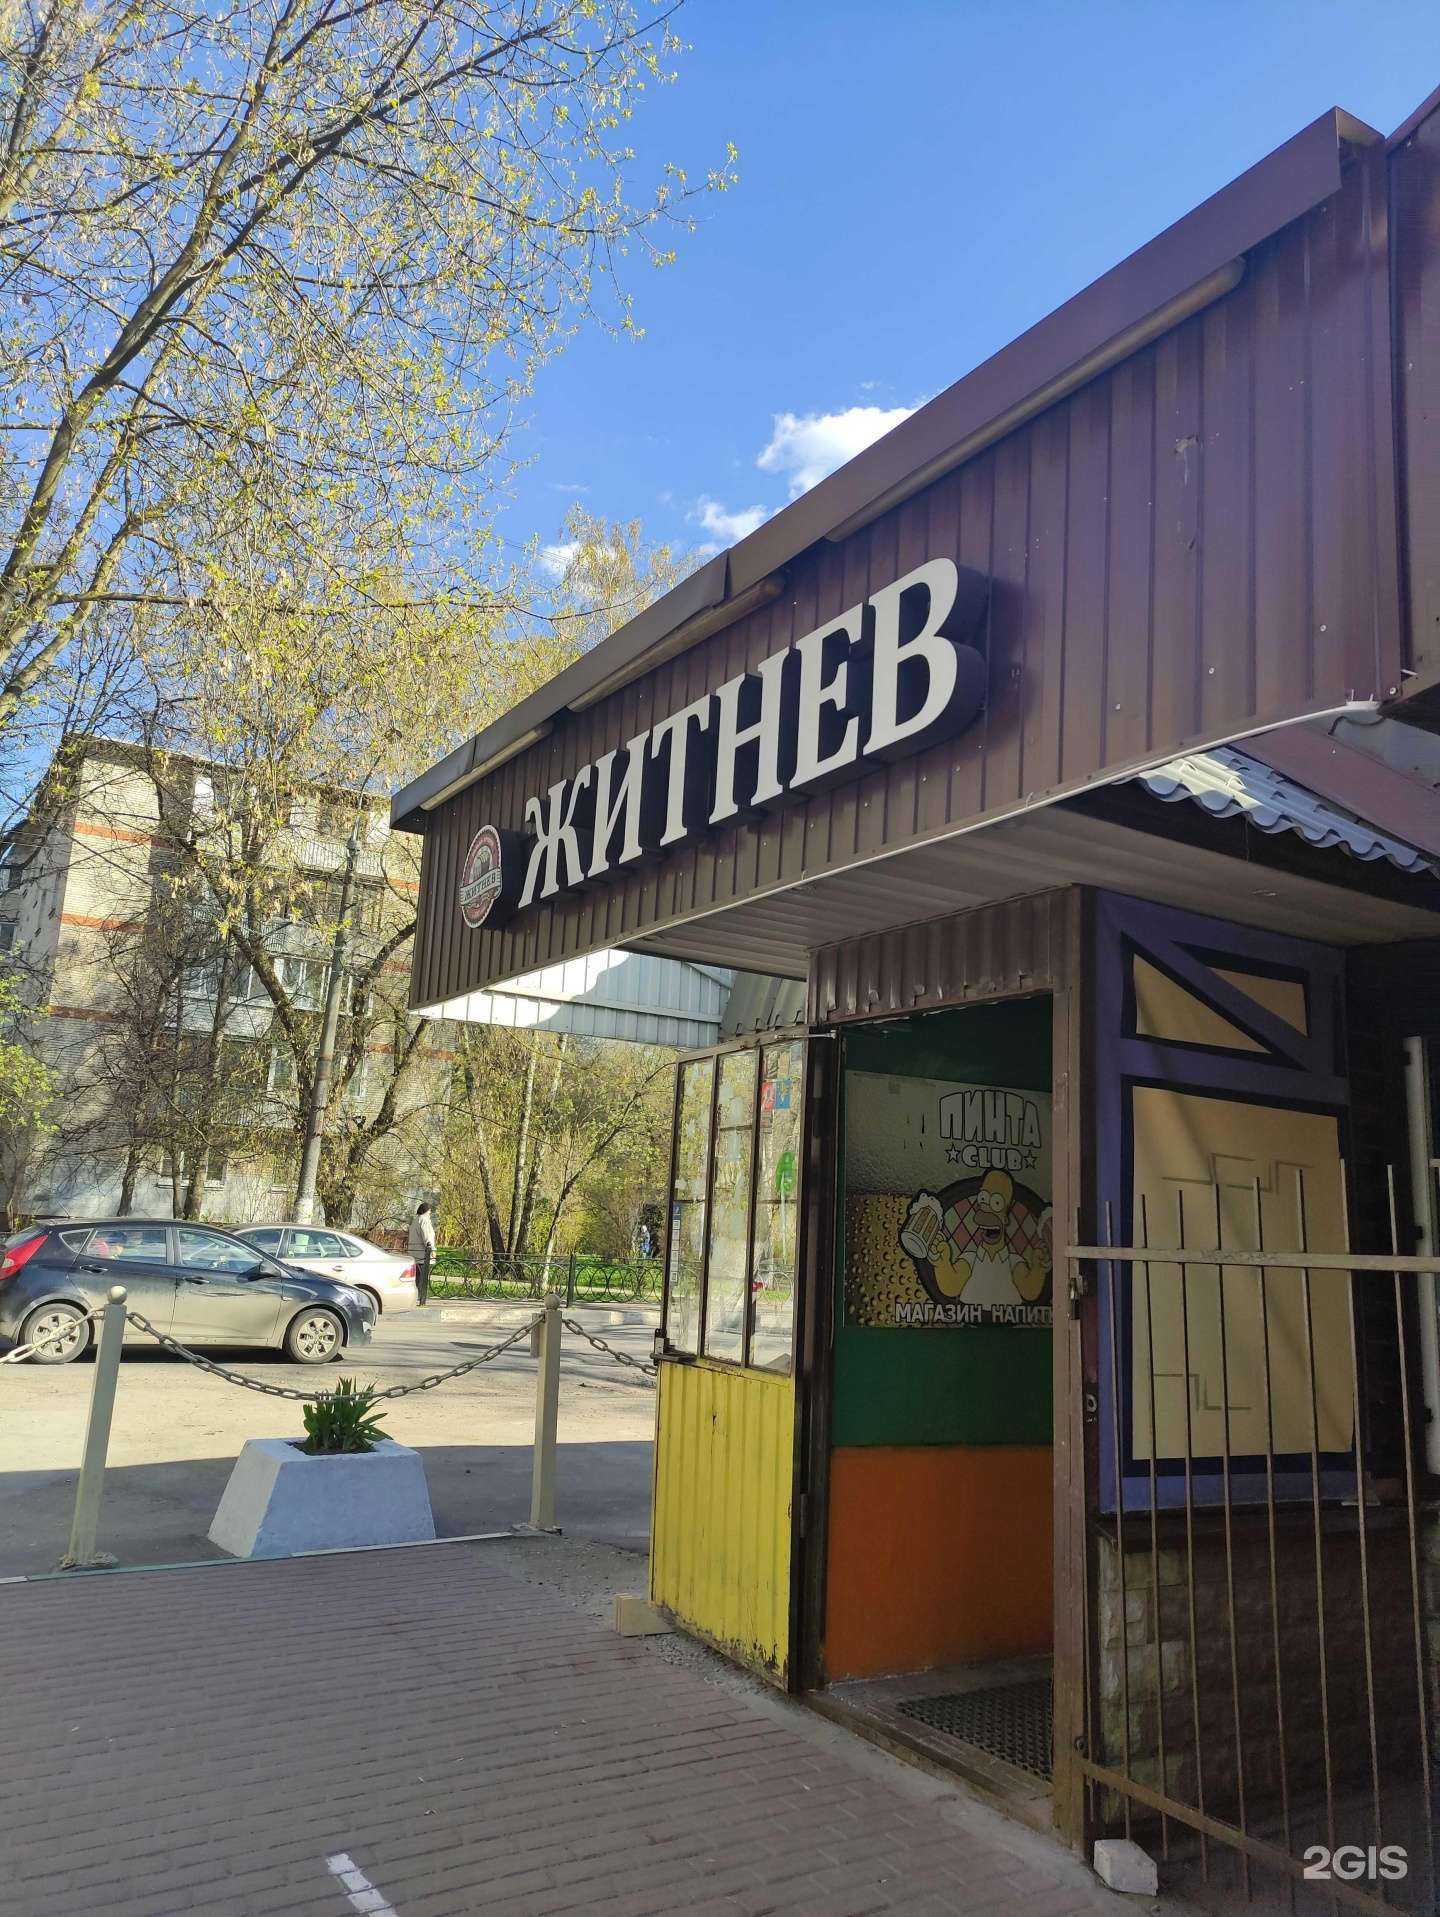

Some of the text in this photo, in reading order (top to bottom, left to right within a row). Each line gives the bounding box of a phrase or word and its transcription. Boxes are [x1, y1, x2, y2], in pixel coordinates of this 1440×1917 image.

[518, 557, 959, 909] ЖИТНЕВ
[464, 872, 497, 901] ЖИТНЕВ
[939, 1089, 1042, 1148] ПИНТА
[962, 1144, 1023, 1171] CLUB
[895, 1302, 983, 1323] МАГАЗИН
